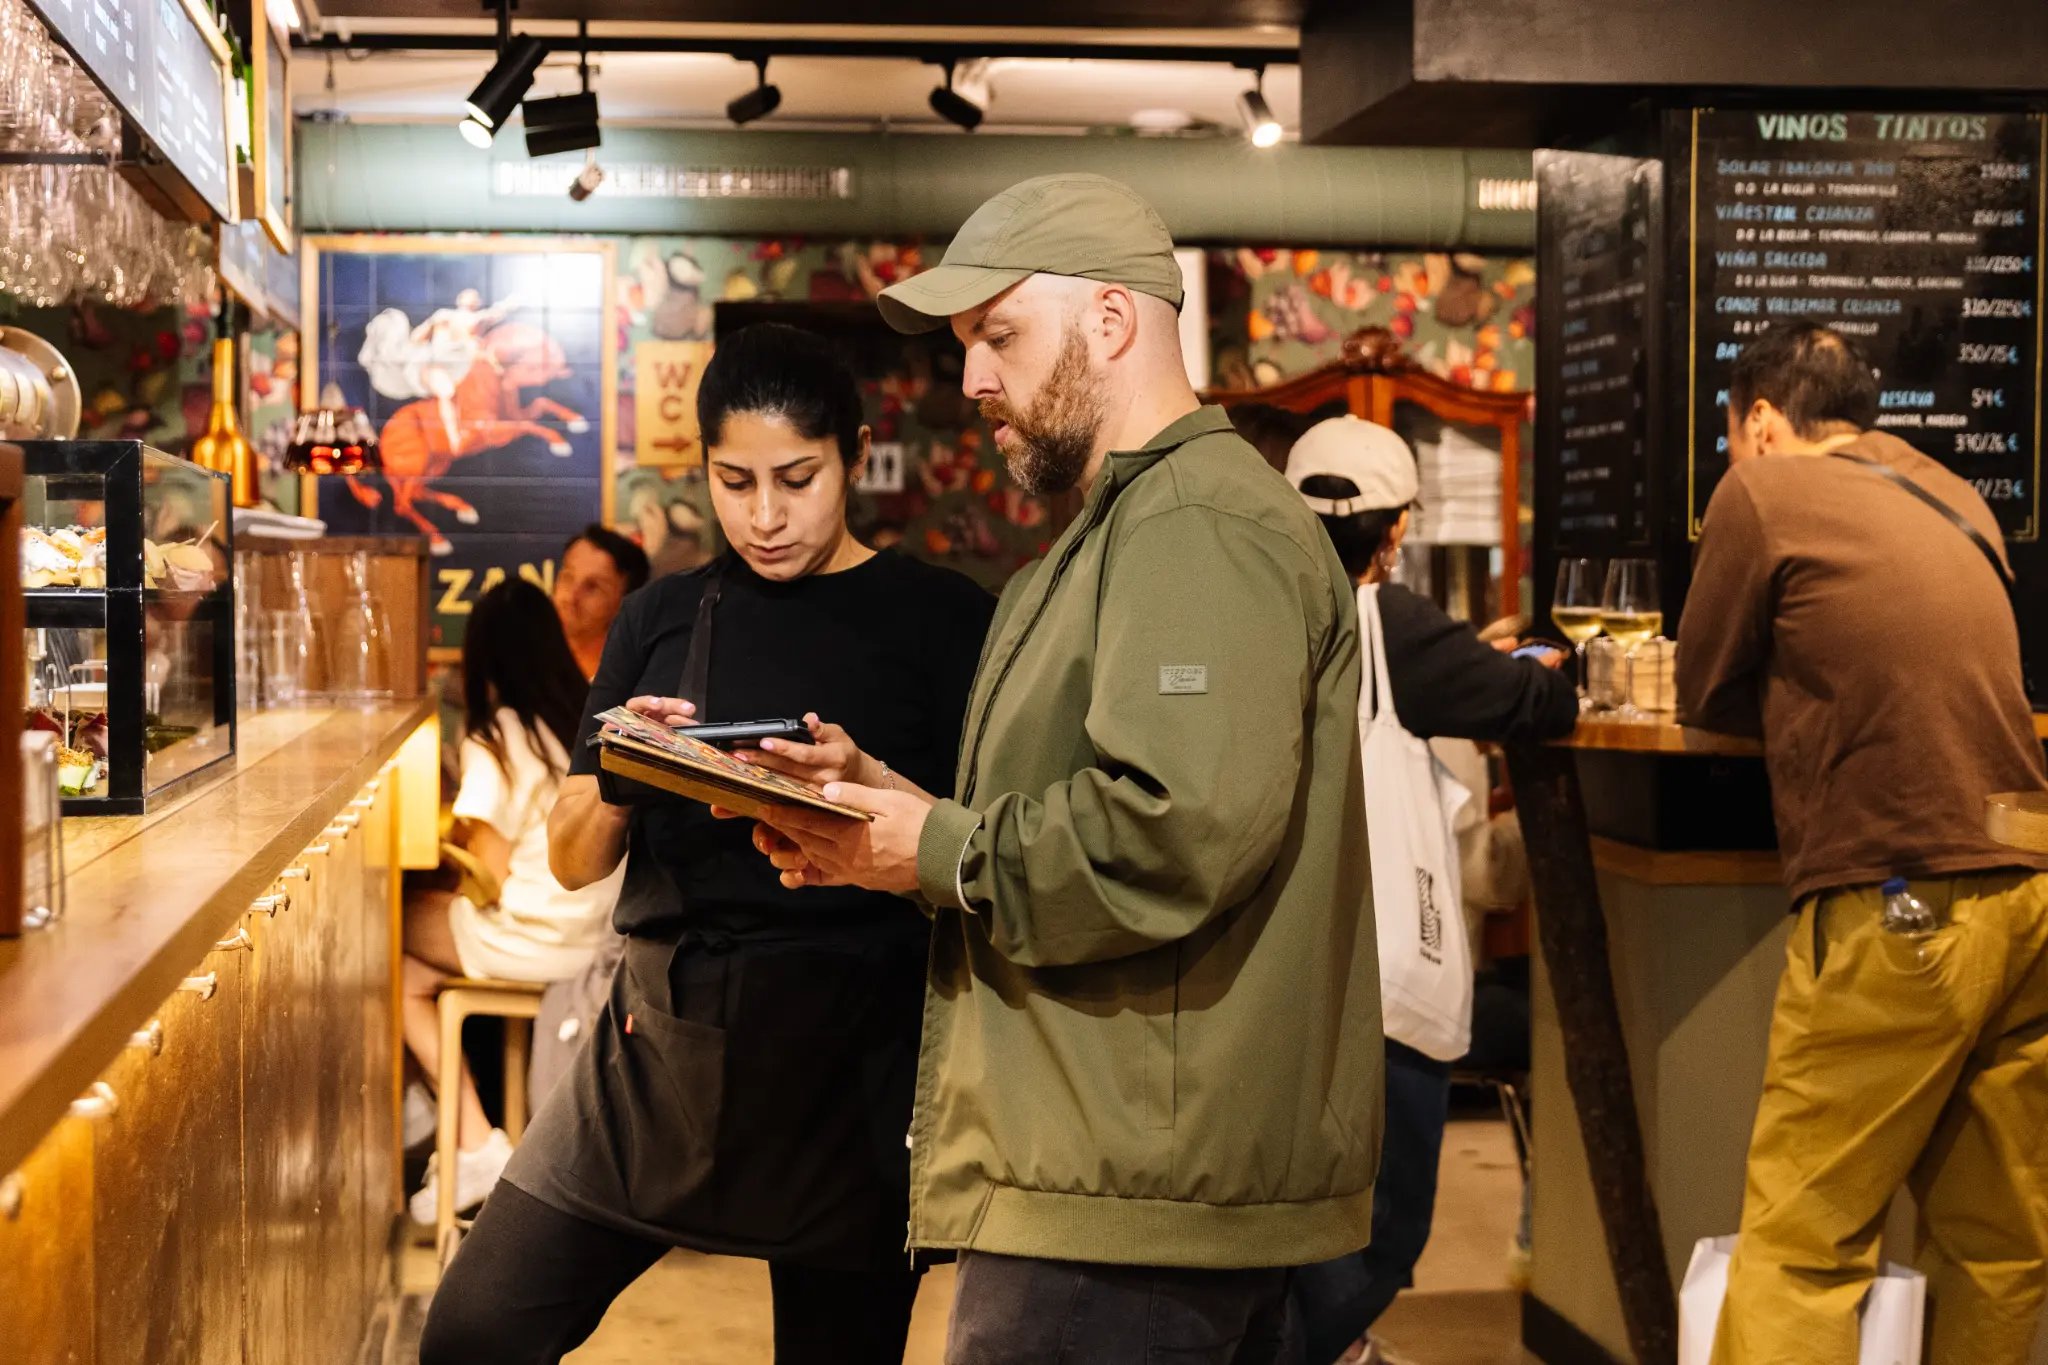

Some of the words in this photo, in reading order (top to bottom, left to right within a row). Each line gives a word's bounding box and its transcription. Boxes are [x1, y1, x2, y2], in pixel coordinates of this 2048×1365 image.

[1758, 113, 1848, 141] VINOS
[1873, 114, 1987, 141] TINTOS
[1805, 204, 1875, 222] CRIANZA
[1715, 249, 1758, 267] VIÑA
[1715, 296, 1760, 314] CONDE
[1765, 297, 1838, 314] VALDEMAR
[1842, 298, 1901, 314] CRIANZA
[1879, 391, 1935, 408] RESERVA
